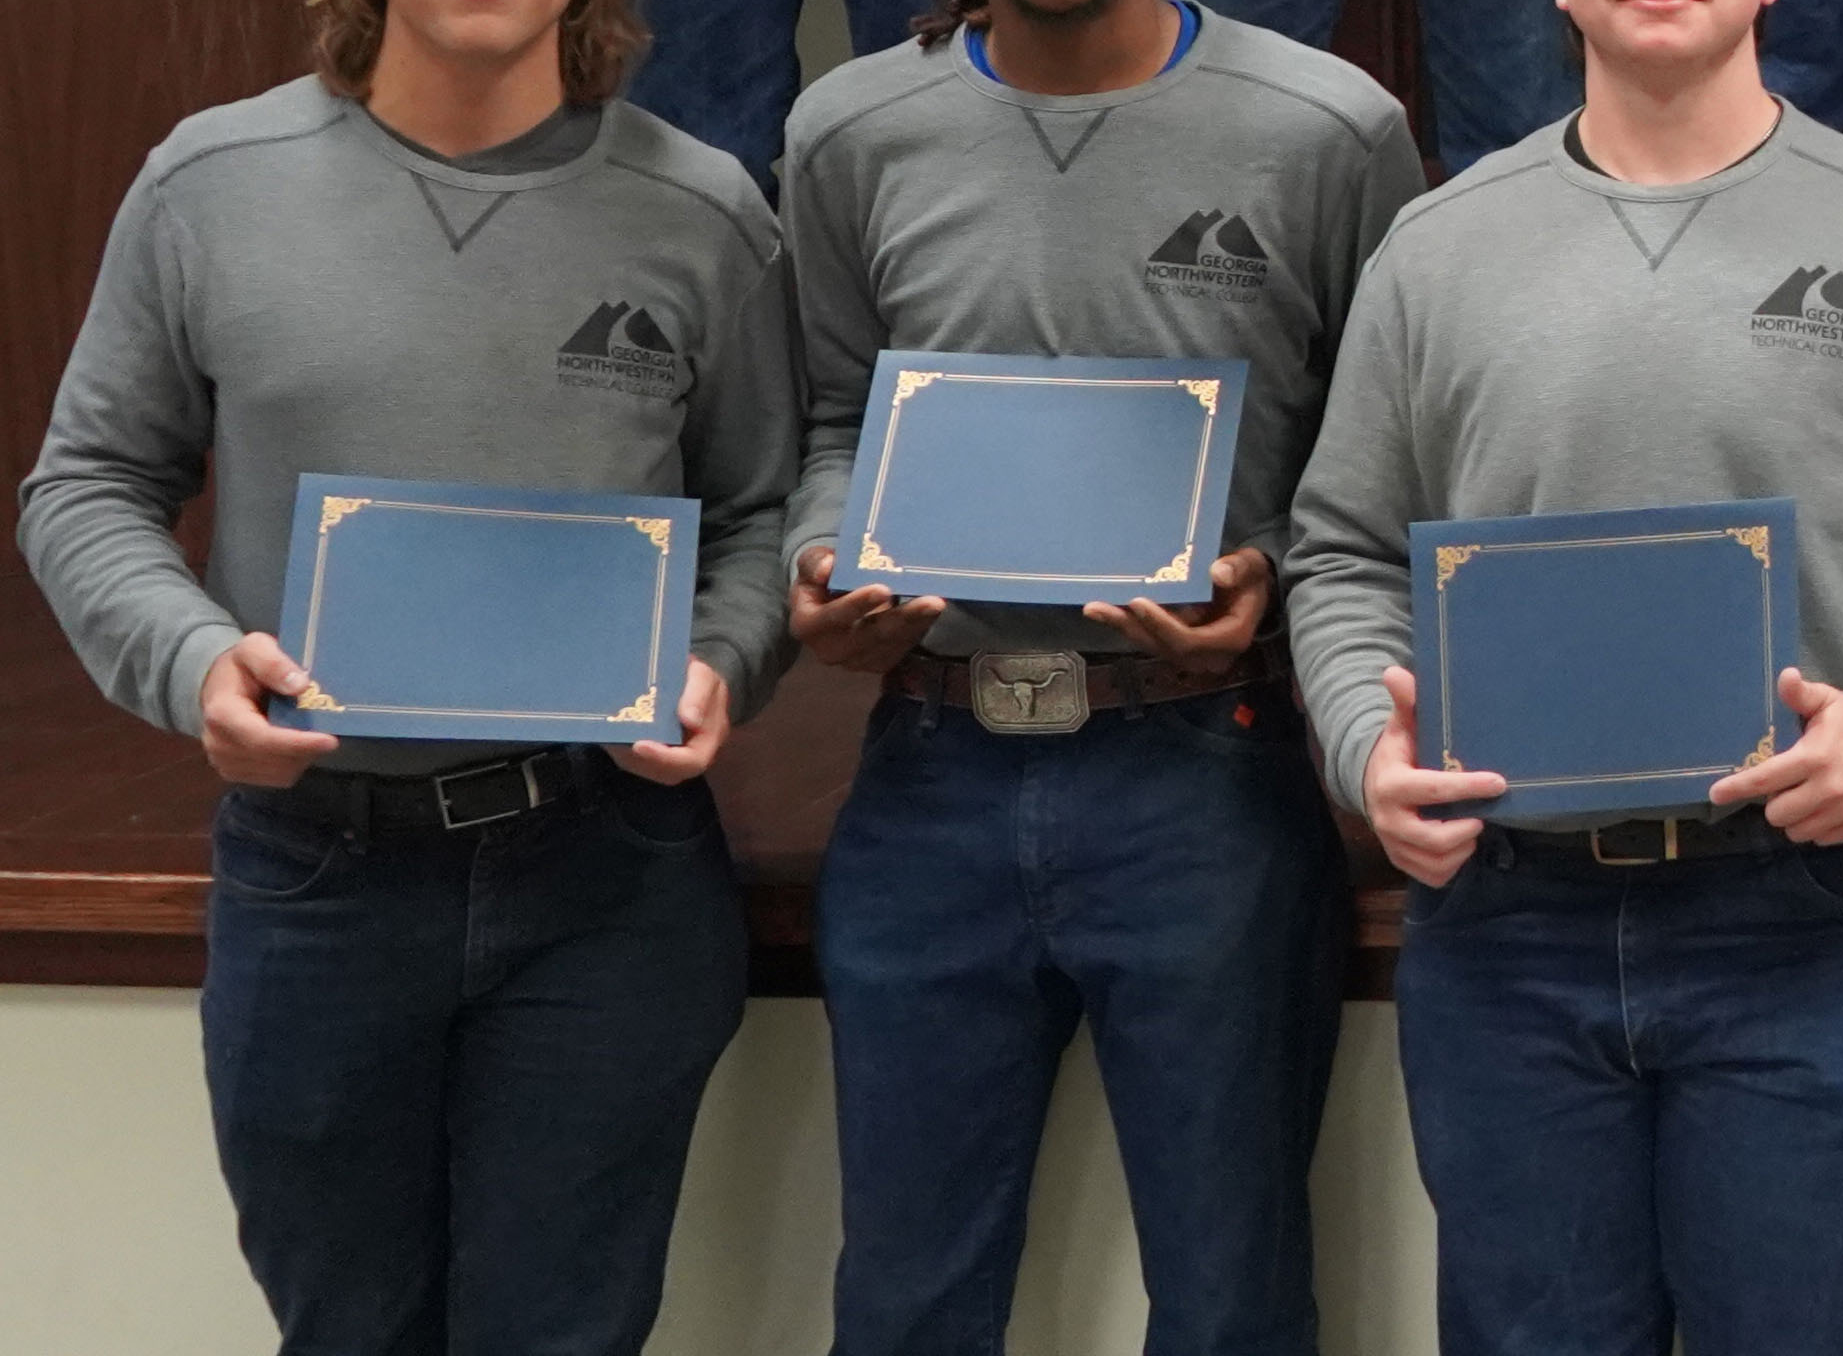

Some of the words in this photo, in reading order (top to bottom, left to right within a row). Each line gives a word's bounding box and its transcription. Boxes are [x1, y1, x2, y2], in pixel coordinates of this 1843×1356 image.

[1200, 255, 1267, 274] GEORGIA
[1145, 265, 1266, 288] NORTHWESTERN
[1144, 283, 1212, 300] TECHNICAL
[1751, 335, 1817, 354] TECHNICAL
[611, 346, 675, 369] GEORGIA
[558, 357, 675, 383] NORTHWESTERN
